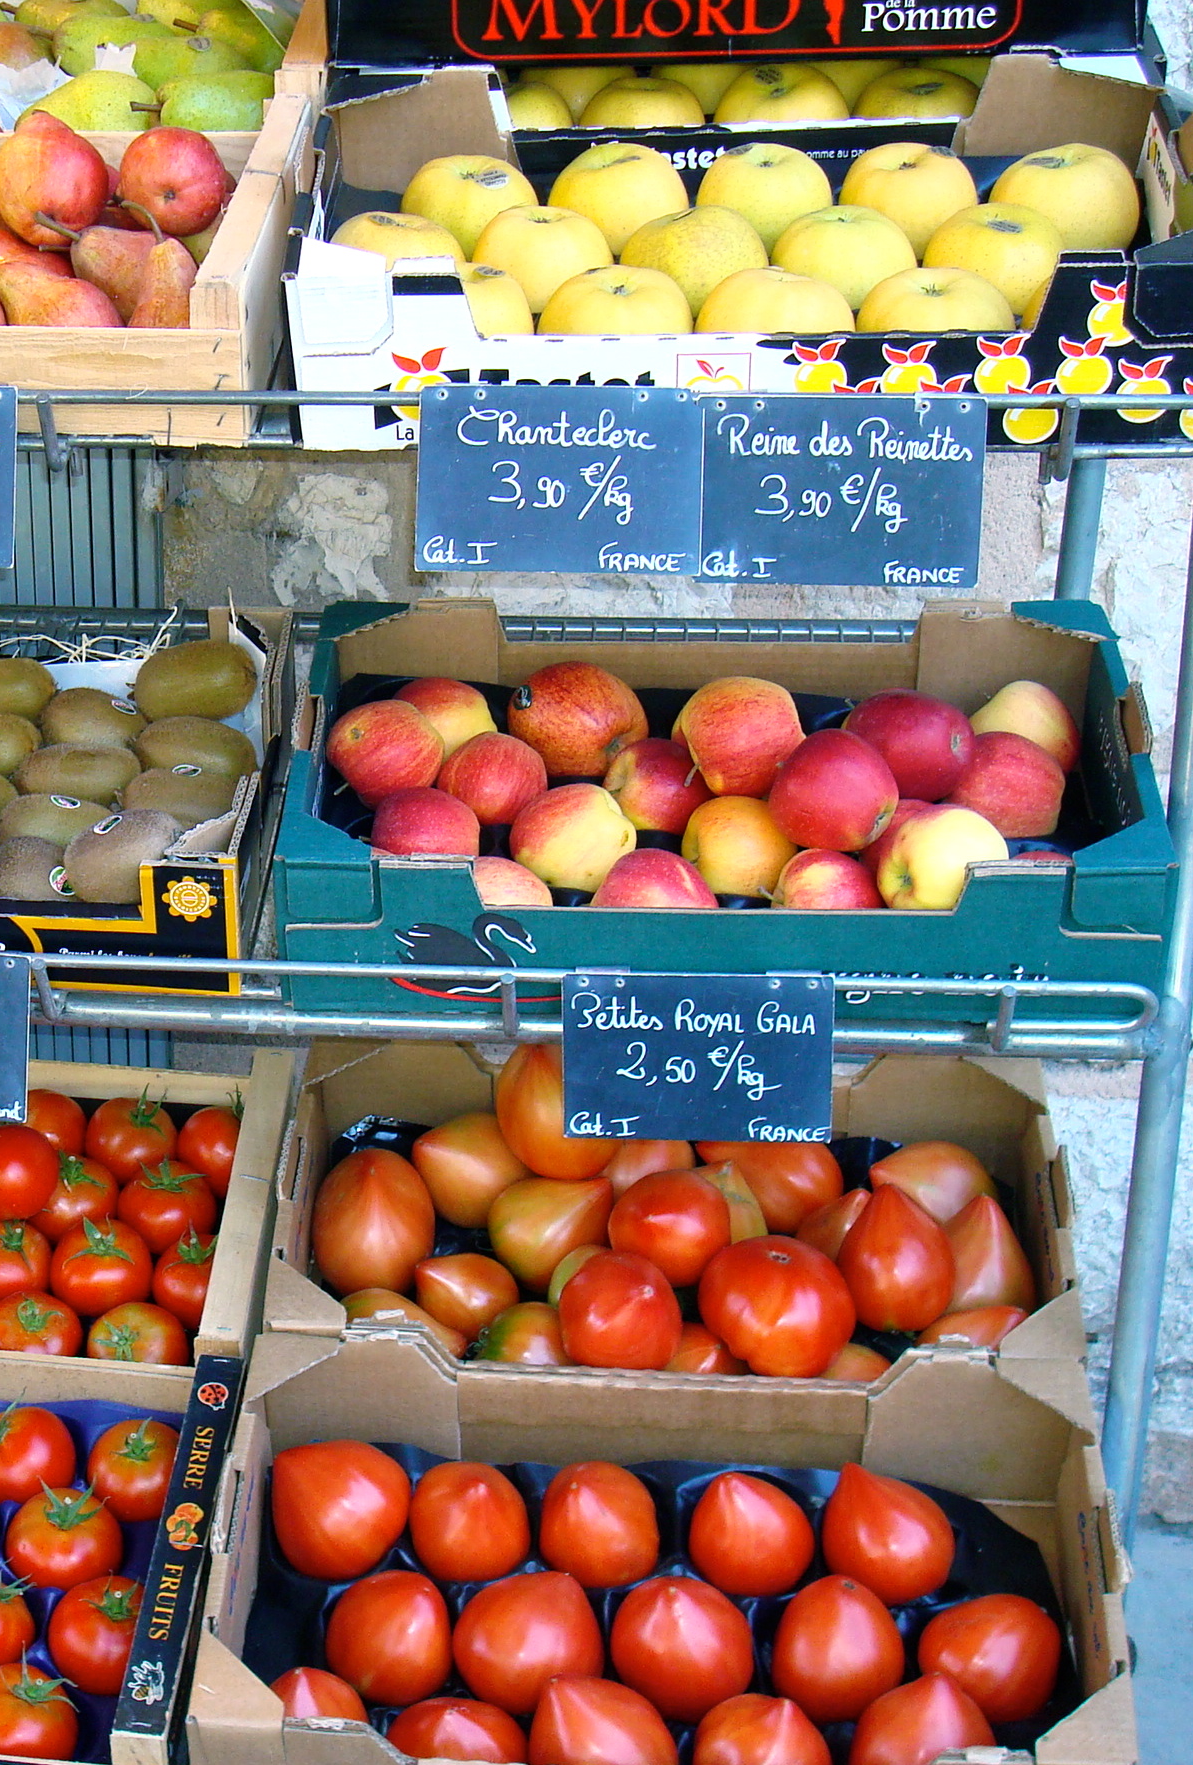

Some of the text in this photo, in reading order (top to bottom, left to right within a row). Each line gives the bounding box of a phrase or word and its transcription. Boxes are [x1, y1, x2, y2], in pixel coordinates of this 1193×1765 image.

[861, 3, 997, 32] Pomme
[457, 405, 657, 450] Chanteclerc
[717, 413, 974, 464] Reine des Reinettes
[488, 460, 566, 510] 3,90
[754, 474, 832, 523] 3,90
[597, 541, 687, 572] FRANCE
[883, 559, 965, 584] FRANCE
[571, 991, 816, 1038] Petites ROYAL GALA
[615, 1041, 696, 1087] 2,50
[748, 1115, 831, 1143] FRANCE
[182, 1425, 216, 1490] SERRE
[147, 1562, 185, 1642] FRUITS
